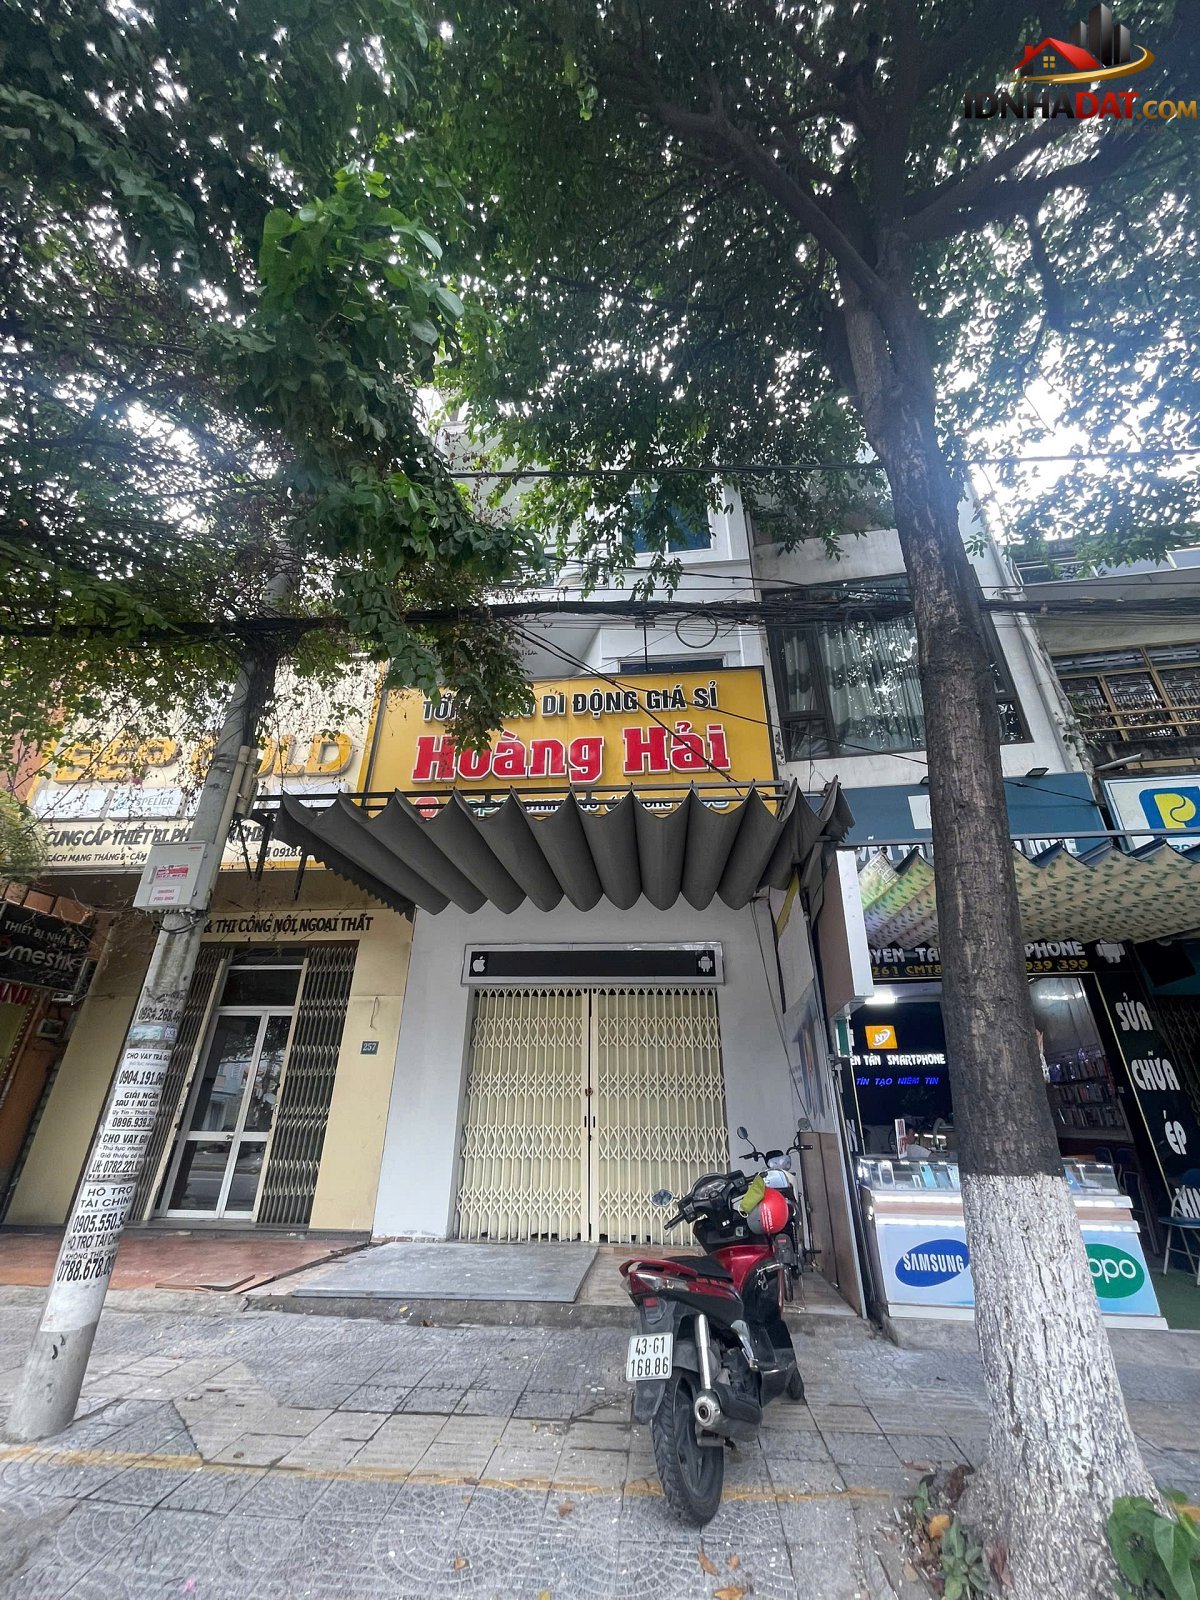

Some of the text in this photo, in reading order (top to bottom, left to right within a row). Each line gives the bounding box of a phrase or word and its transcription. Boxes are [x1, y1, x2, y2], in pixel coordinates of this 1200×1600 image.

[541, 693, 566, 716] DI
[572, 689, 639, 719] ĐỘNG
[646, 684, 688, 712] GIÁ
[694, 680, 719, 709] SỈ
[411, 721, 731, 785] Hoàng Hải
[203, 920, 212, 933] &
[216, 918, 238, 933] THI
[238, 914, 272, 933] CÔNG
[341, 913, 374, 931] THẤT
[872, 967, 899, 977] 261
[904, 965, 942, 977] CMT8
[1058, 959, 1089, 971] 399
[1115, 992, 1154, 1032] SỬA
[363, 1042, 377, 1051] 257
[886, 1053, 947, 1066] SMARTPHONE
[1131, 1050, 1181, 1091] CHỮA
[102, 1133, 121, 1143] CHO
[123, 1134, 139, 1144] VAY
[902, 1252, 965, 1274] SAMSUNG
[635, 1336, 665, 1356] 43-G1
[630, 1356, 669, 1378] 168.86
